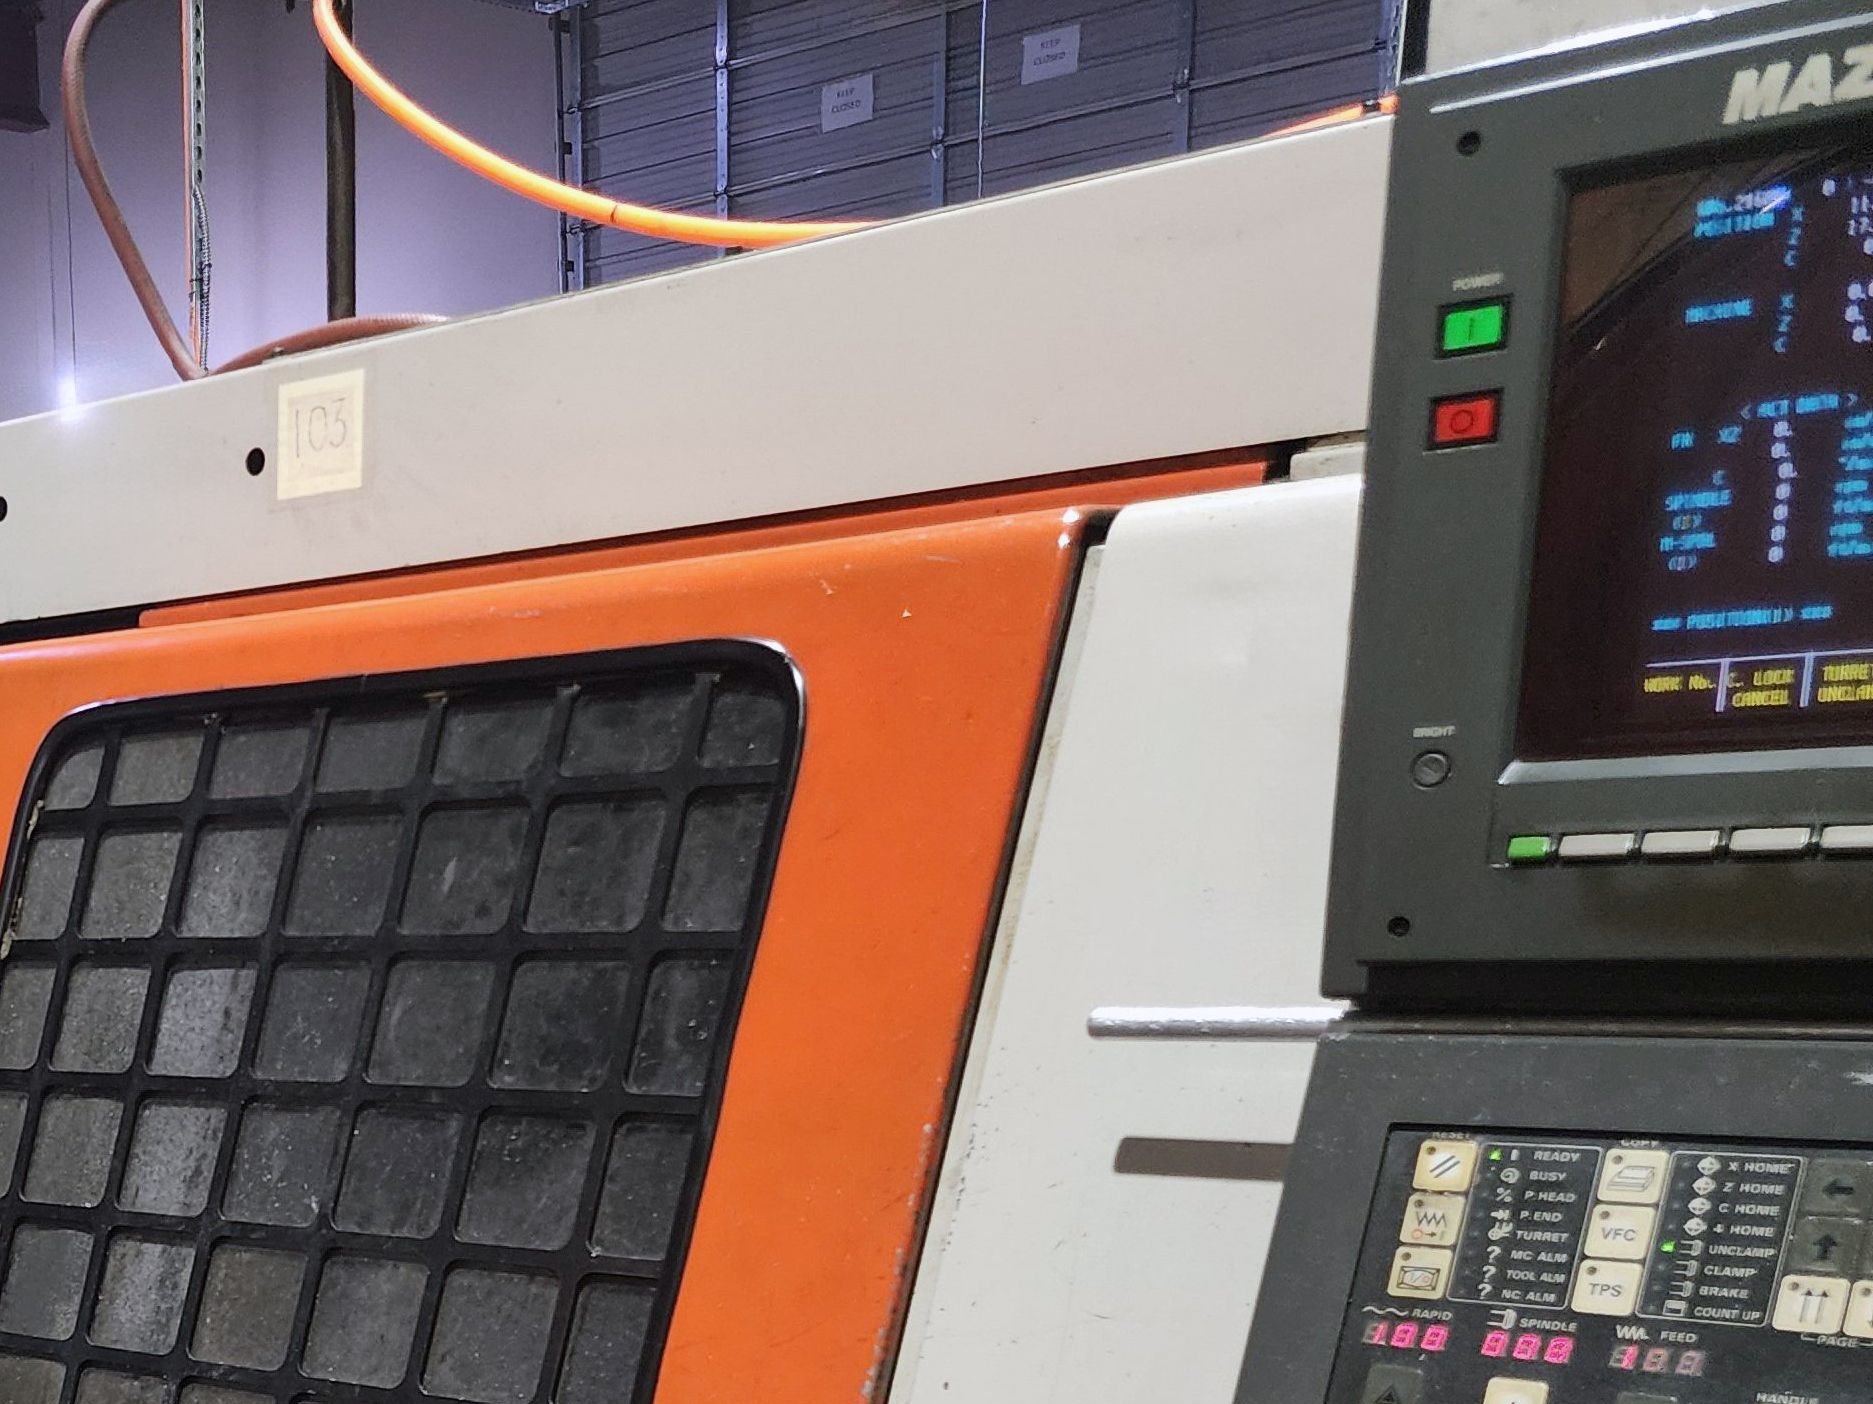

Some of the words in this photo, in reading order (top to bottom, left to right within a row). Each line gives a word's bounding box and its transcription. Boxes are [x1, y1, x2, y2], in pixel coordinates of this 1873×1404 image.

[1732, 689, 1790, 708] CANCEL
[1533, 1150, 1581, 1162] READY
[1745, 1161, 1790, 1174] HOME
[1529, 1171, 1567, 1182] BUSY
[1723, 1181, 1734, 1194] Z
[1739, 1183, 1786, 1196] HOME
[1734, 1204, 1780, 1217] HOME
[1515, 1230, 1570, 1243] TURRET
[1600, 1226, 1639, 1242] VFC
[1730, 1224, 1776, 1238] HOME
[1510, 1250, 1533, 1262] MC
[1536, 1251, 1569, 1264] ALM
[1708, 1244, 1776, 1259] UNCLAMP
[1506, 1269, 1537, 1281] TOOL
[1539, 1272, 1567, 1284] ALM
[1703, 1265, 1758, 1279] CLAMP
[1501, 1289, 1523, 1300] NC
[1526, 1291, 1557, 1303] ALM
[1588, 1281, 1623, 1298] TPS
[1699, 1286, 1751, 1300] BRAKE
[1412, 1308, 1453, 1322] RAPID
[1693, 1306, 1741, 1321] COUNT
[1742, 1309, 1762, 1322] UP
[1519, 1317, 1579, 1333] SPINDLE
[1660, 1331, 1699, 1344] FEED
[1816, 1334, 1862, 1349] PAGE
